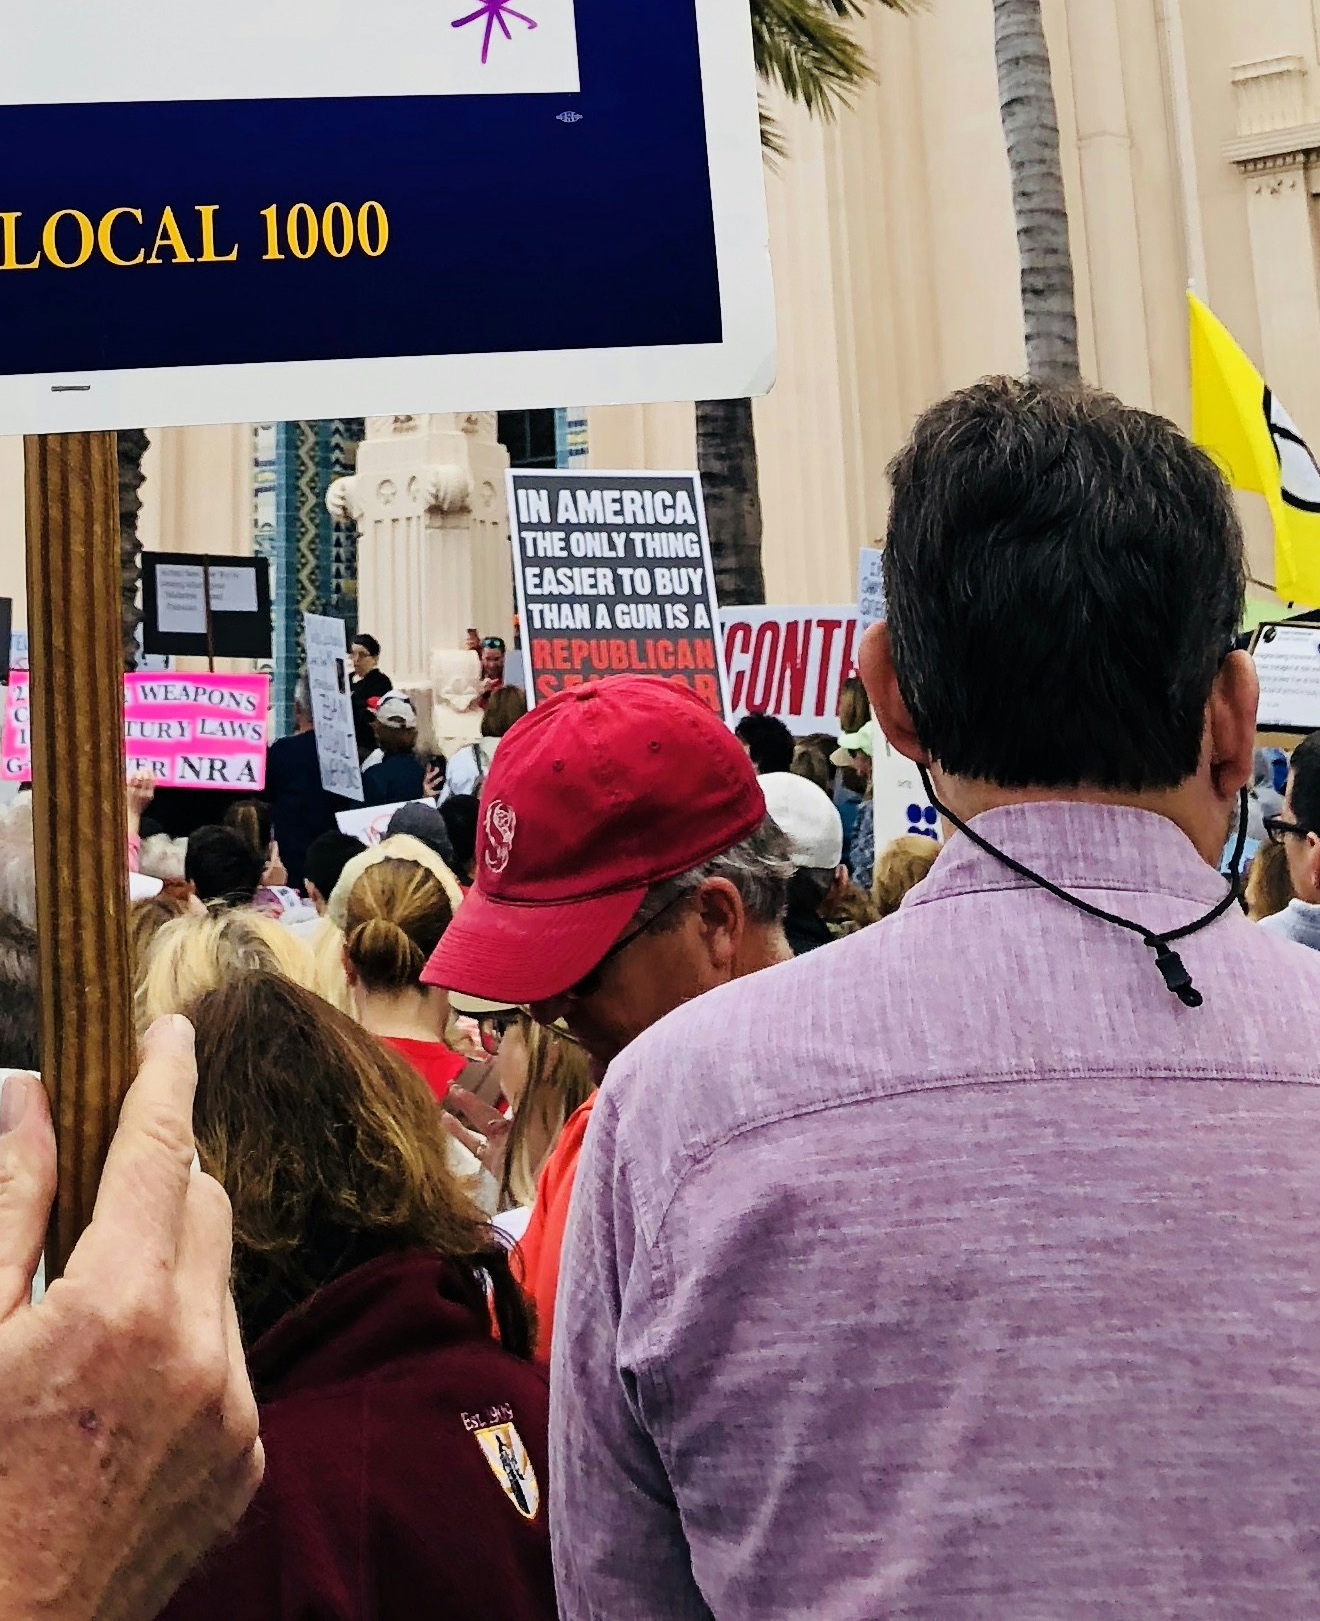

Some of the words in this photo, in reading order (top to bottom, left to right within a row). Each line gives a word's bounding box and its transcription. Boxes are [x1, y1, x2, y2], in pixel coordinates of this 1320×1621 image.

[259, 200, 389, 260] 1000
[517, 489, 551, 524] IN
[557, 489, 697, 525] AMERICA
[521, 531, 568, 558] THE
[569, 531, 627, 558] ONLY
[628, 531, 701, 558] THING
[524, 566, 616, 596] EASIER
[617, 567, 652, 596] TO
[654, 567, 704, 596] BUY
[527, 603, 592, 630] THAN
[595, 603, 612, 630] A
[614, 603, 663, 630] GUN
[664, 603, 690, 630] IS
[694, 603, 712, 629] A
[532, 638, 715, 670] REPUBLICAN
[140, 684, 257, 713] WEAPONS
[200, 719, 263, 741] LAWS
